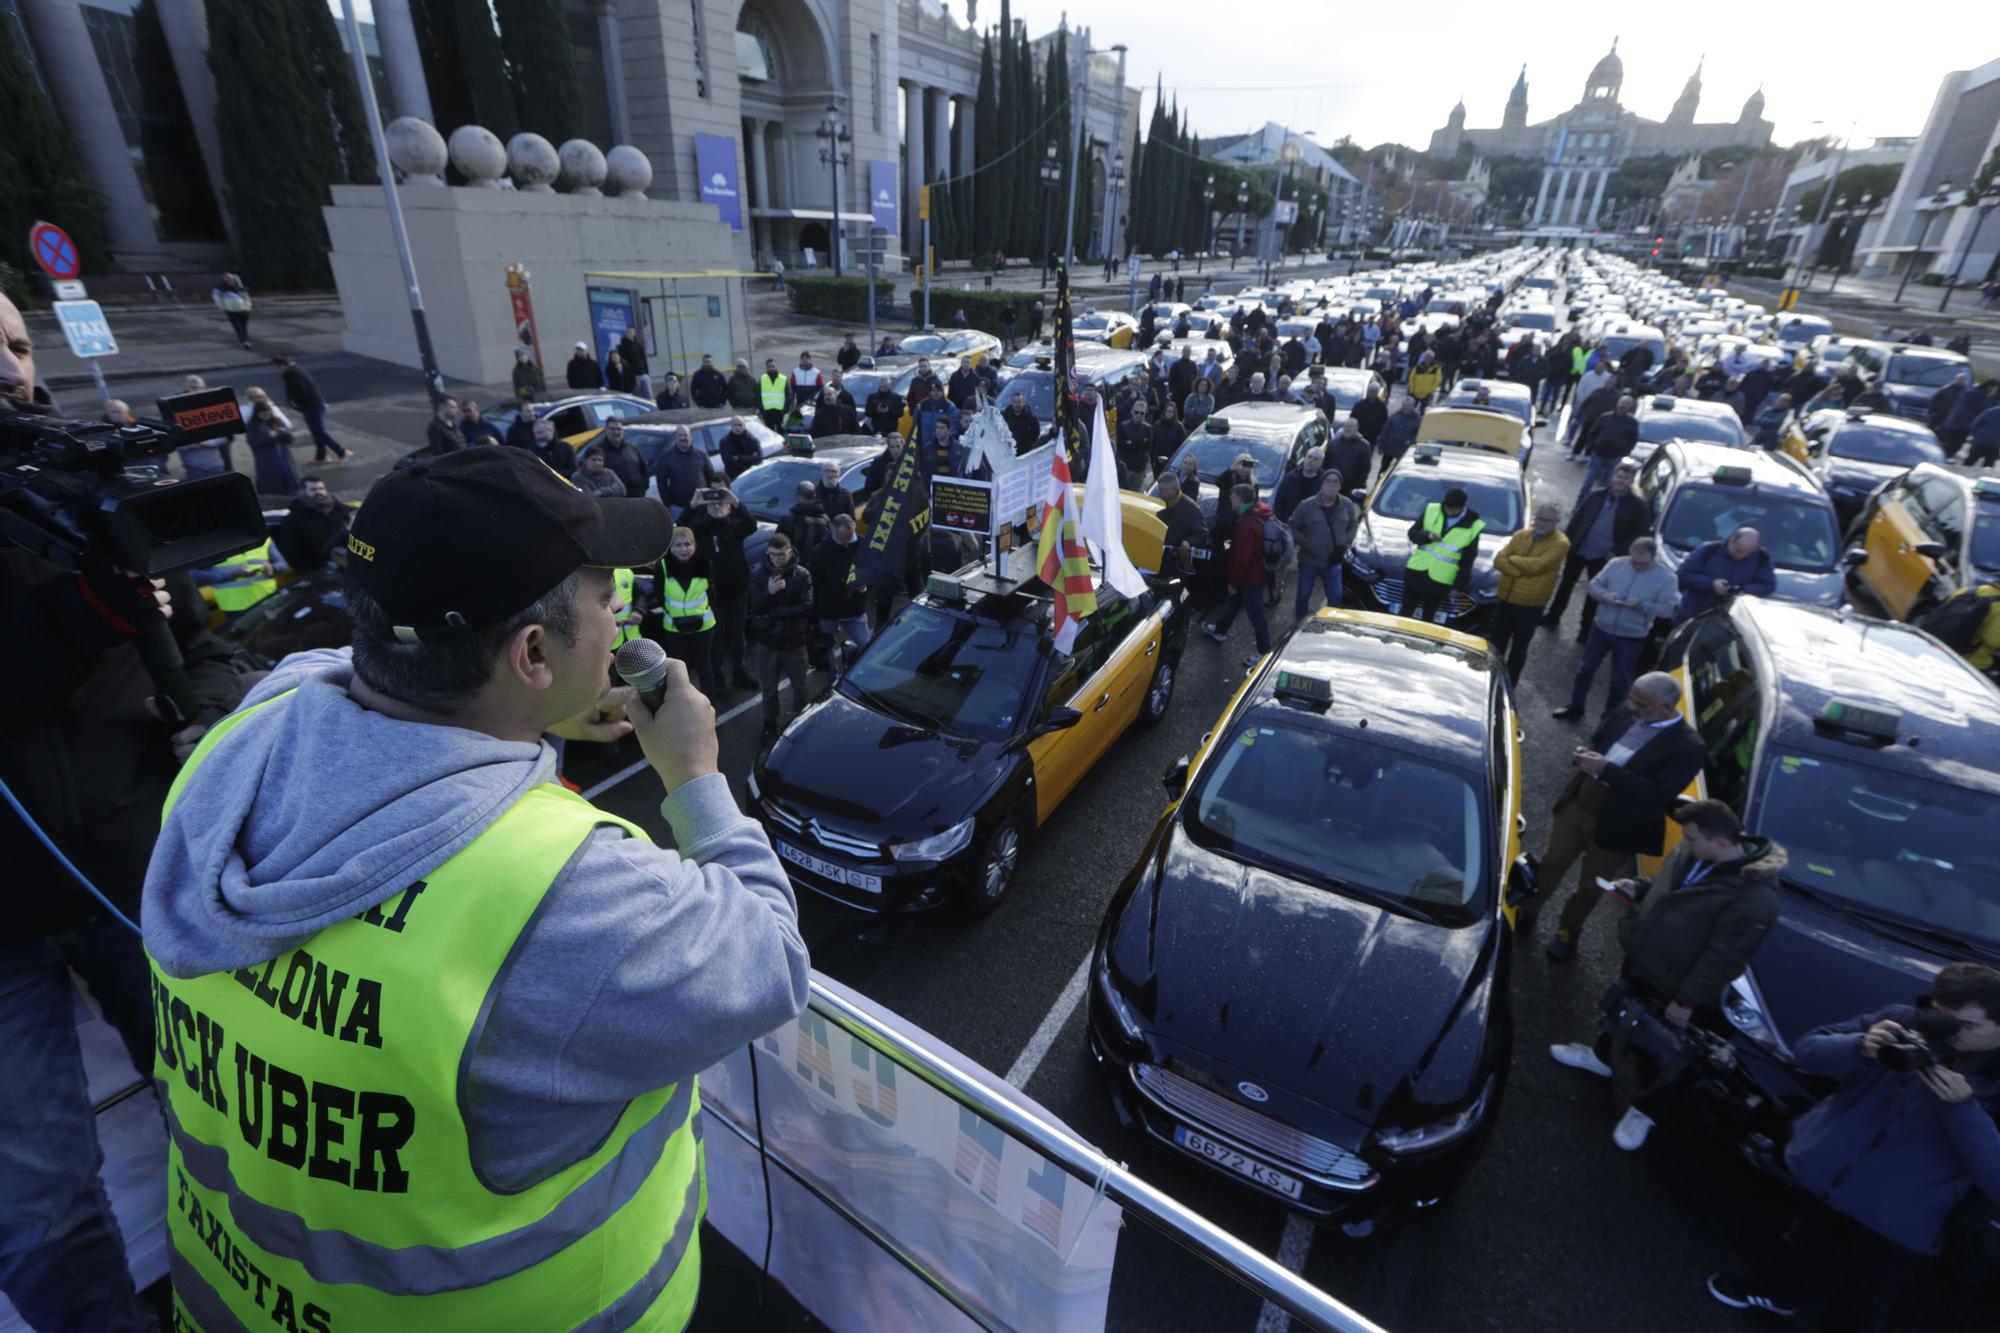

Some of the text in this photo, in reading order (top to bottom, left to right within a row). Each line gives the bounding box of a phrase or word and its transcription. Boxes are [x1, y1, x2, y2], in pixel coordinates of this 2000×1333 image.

[181, 405, 234, 428] betevé
[1289, 676, 1313, 693] TAXI
[782, 844, 841, 881] 4628 JSK
[235, 1041, 416, 1194] UBER
[1189, 1134, 1297, 1195] 6672 KSJ
[176, 1164, 333, 1333] TAXISTAS
